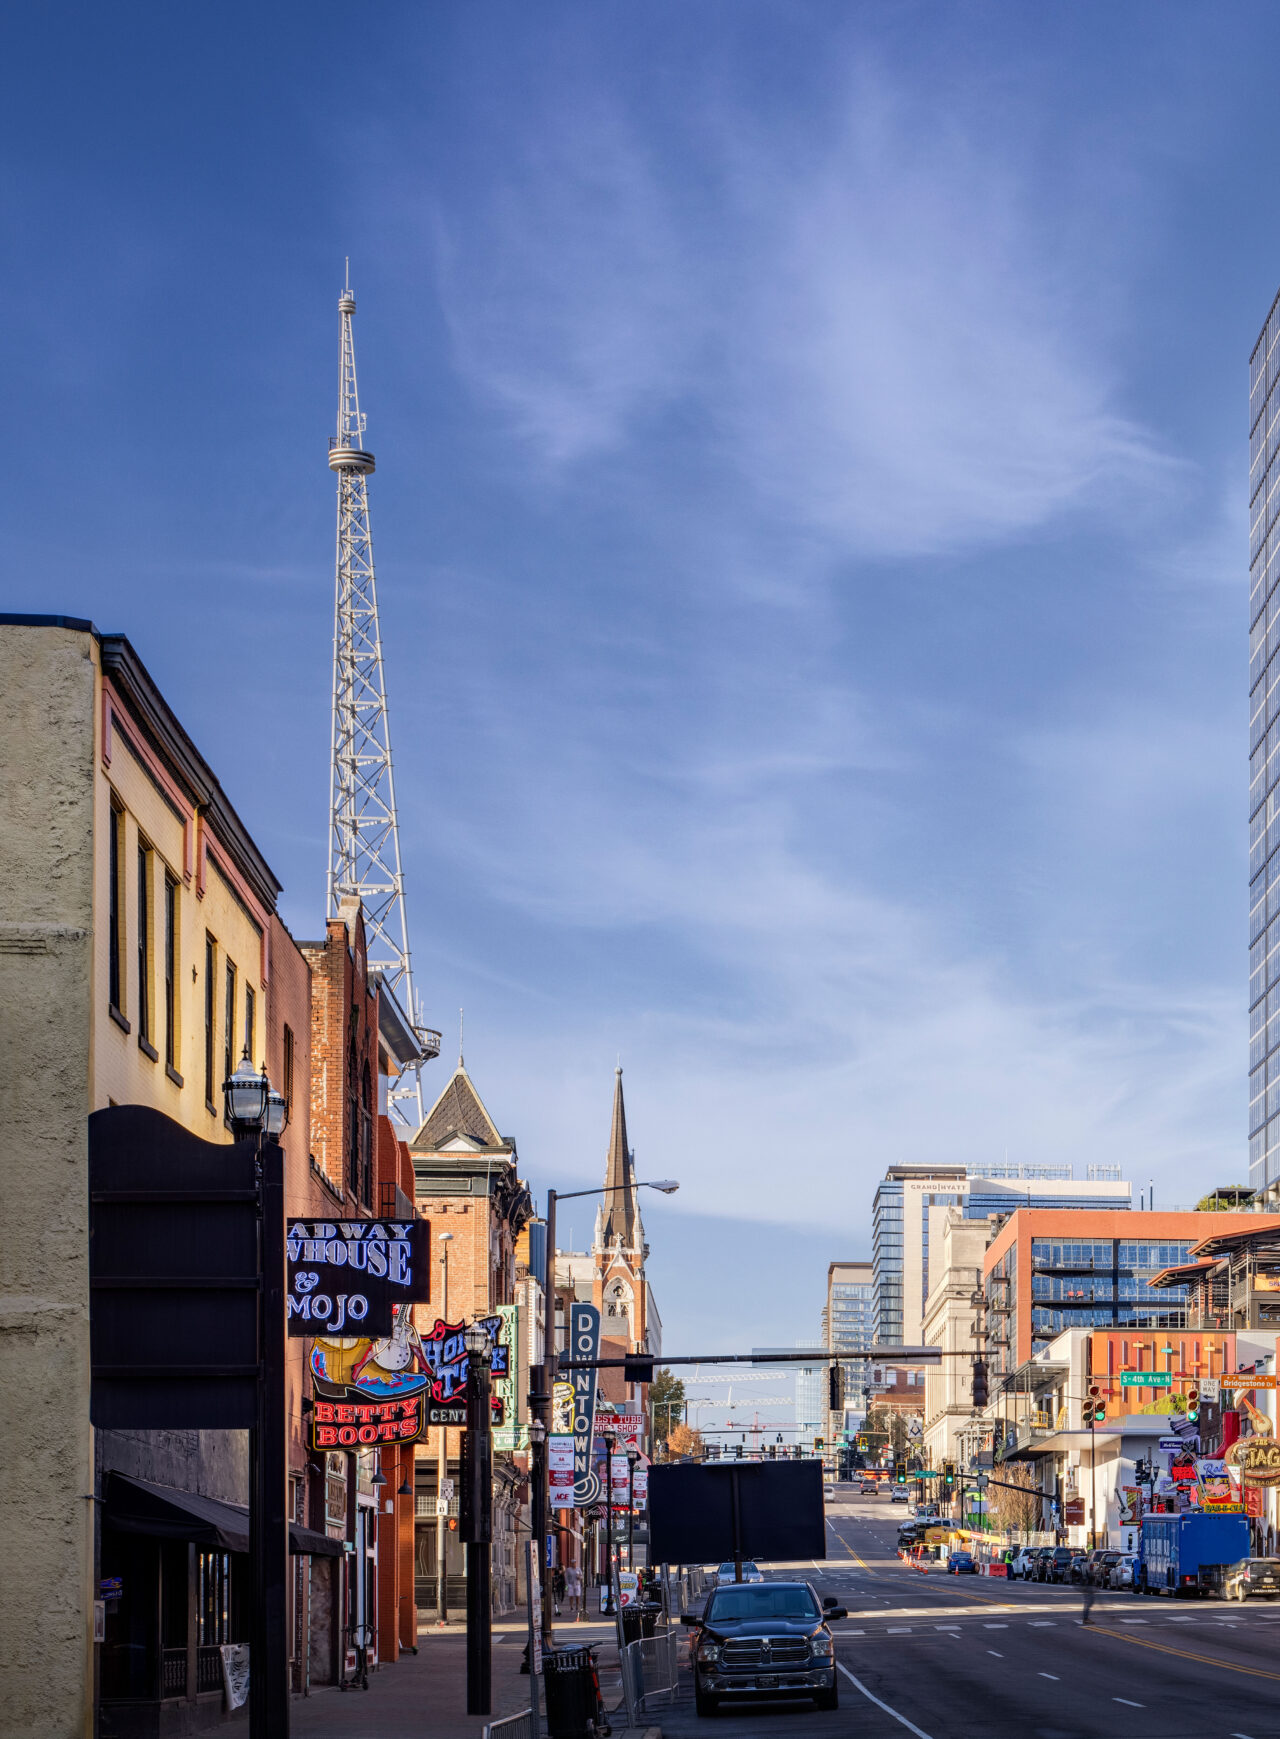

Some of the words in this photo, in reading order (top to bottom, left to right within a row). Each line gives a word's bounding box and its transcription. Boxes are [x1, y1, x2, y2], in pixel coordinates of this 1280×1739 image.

[288, 1222, 414, 1240] ADWAY
[287, 1239, 412, 1286] WHOUSE
[294, 1271, 319, 1293] &
[574, 1313, 594, 1473] DOWNTOWN
[1223, 1380, 1265, 1388] Bridgestone
[314, 1397, 421, 1423] BETTY
[594, 1415, 615, 1423] EST
[619, 1415, 643, 1423] TUBB
[318, 1418, 419, 1446] BOOTS
[617, 1424, 638, 1433] SHOP
[554, 1493, 571, 1501] ACE
